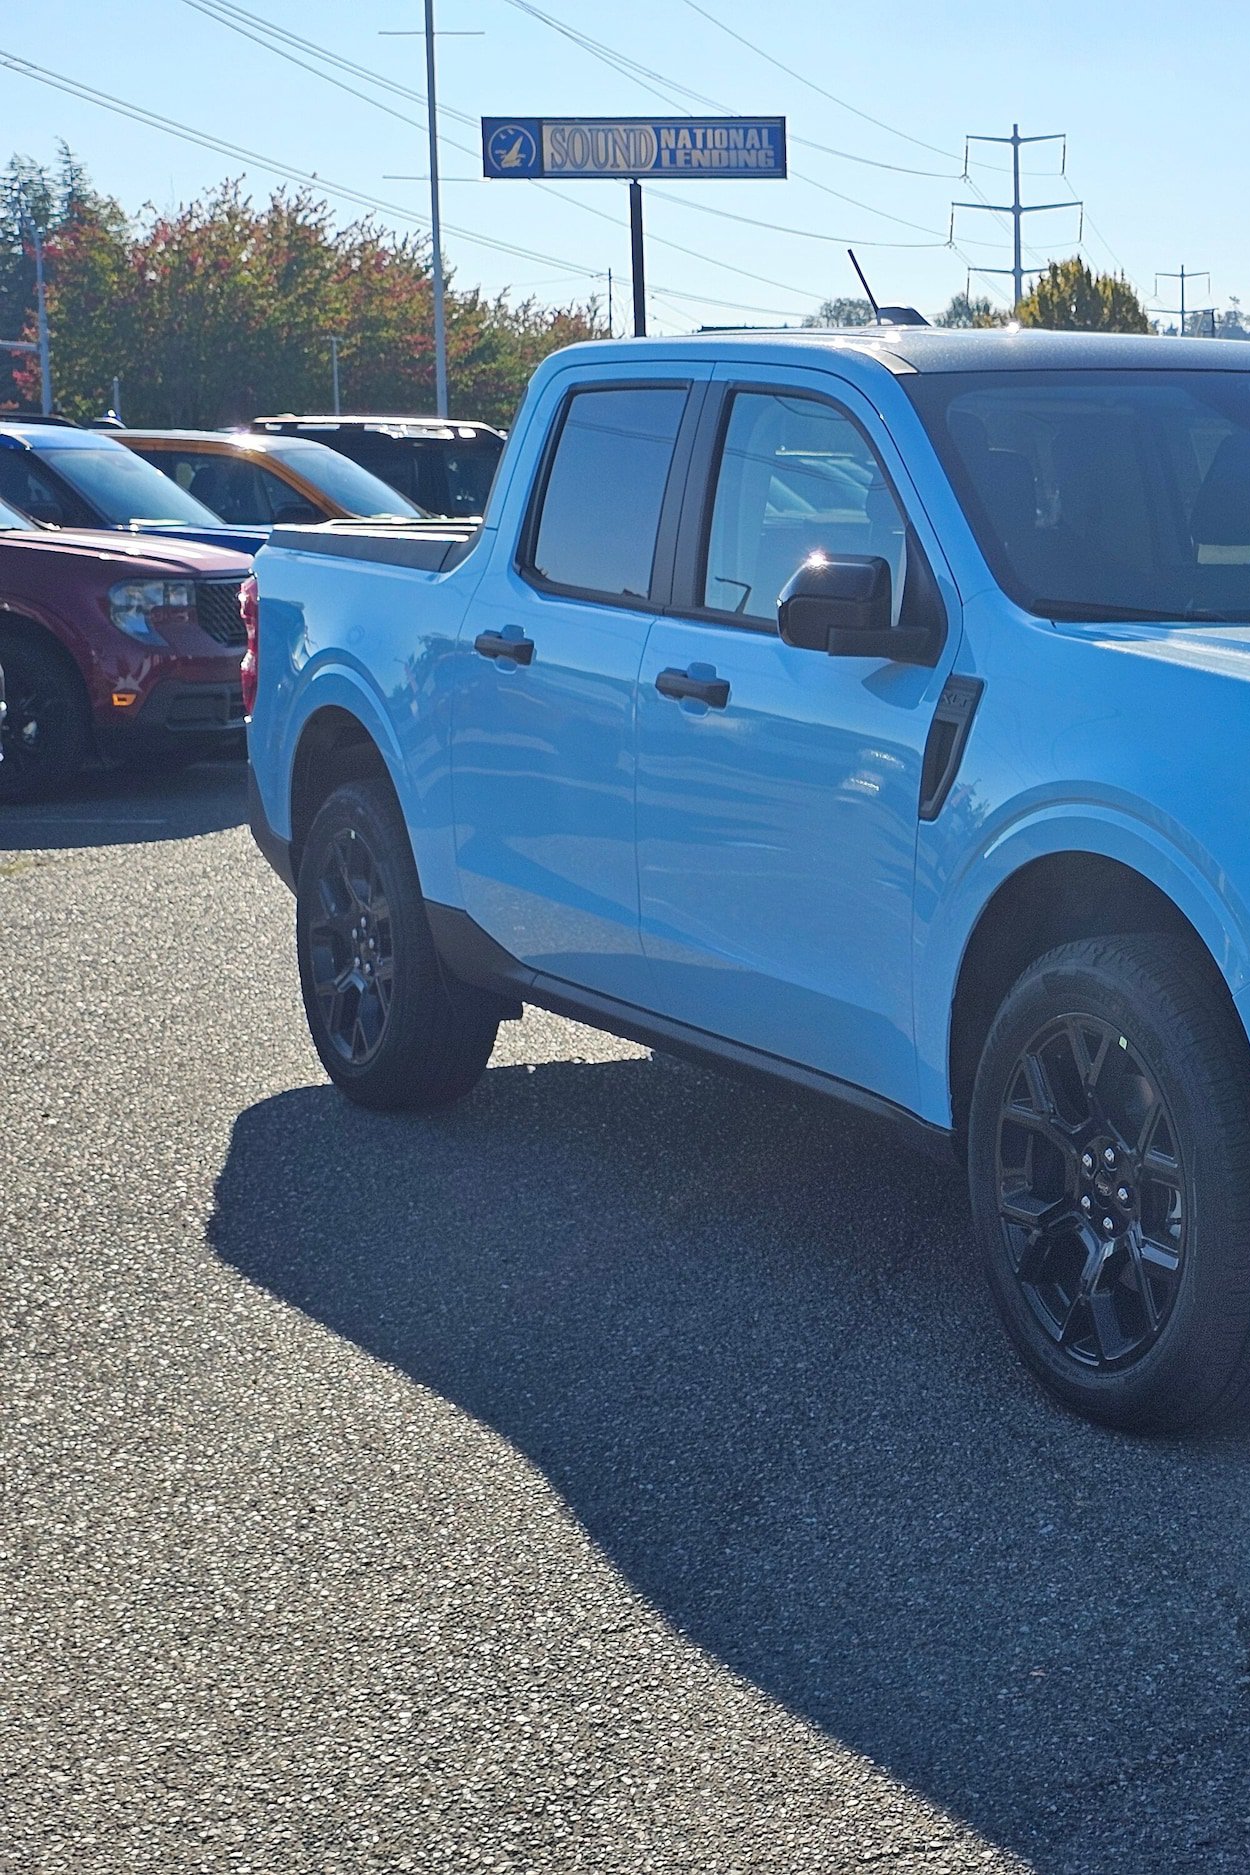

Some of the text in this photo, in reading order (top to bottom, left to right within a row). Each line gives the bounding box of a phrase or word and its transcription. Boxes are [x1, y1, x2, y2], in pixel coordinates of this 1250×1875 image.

[550, 127, 654, 170] SOUND
[660, 128, 774, 149] NATIONAL
[660, 149, 775, 168] LENDING
